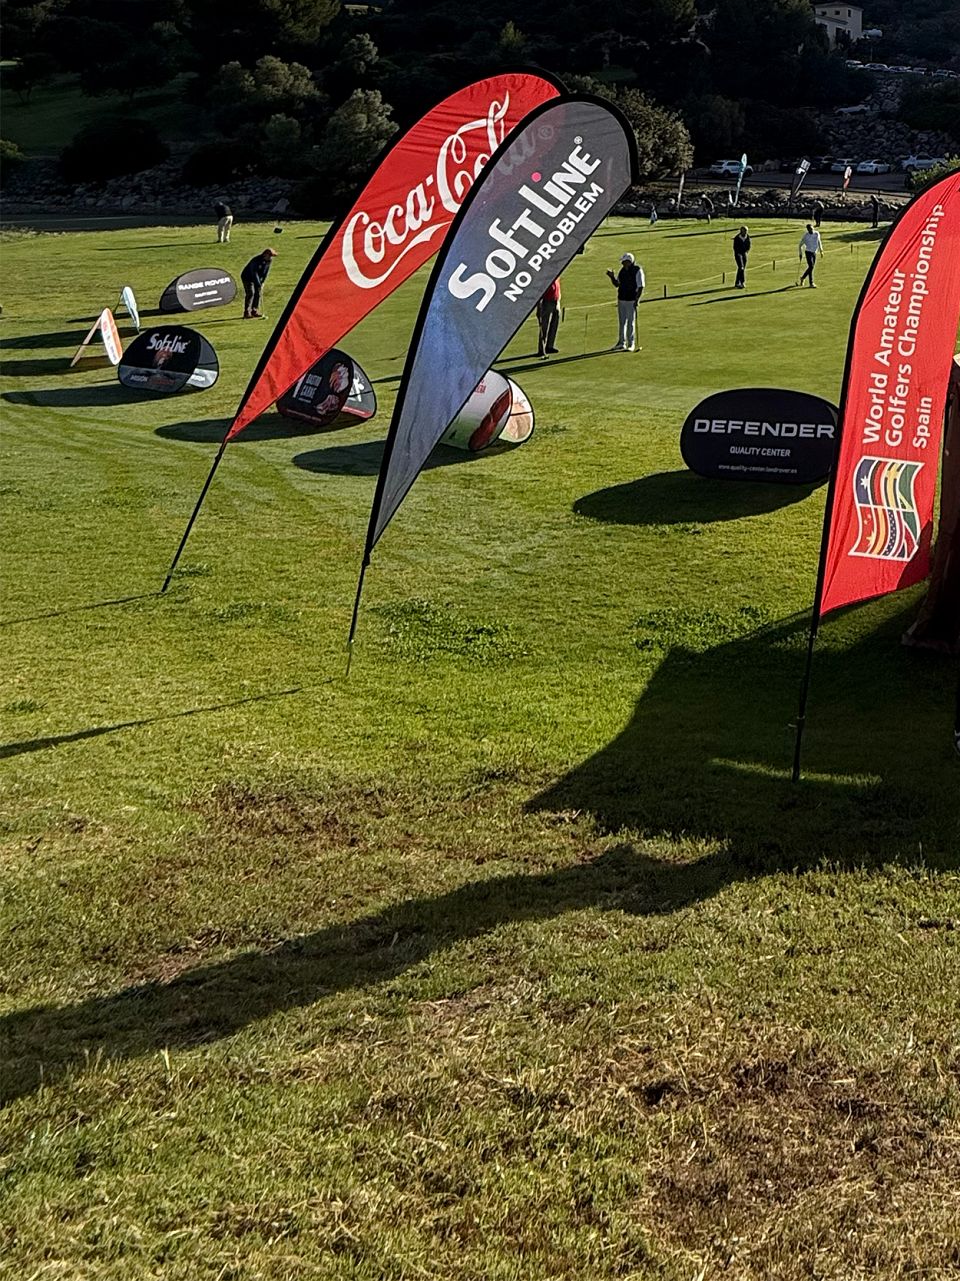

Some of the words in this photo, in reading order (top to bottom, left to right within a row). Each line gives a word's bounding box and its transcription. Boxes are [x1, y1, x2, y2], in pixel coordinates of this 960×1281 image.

[342, 90, 516, 289] Coca-Col
[503, 277, 532, 303] NO
[527, 182, 605, 271] PROBLEM
[898, 204, 945, 358] Championship
[178, 281, 204, 291] RANGE
[204, 277, 231, 287] ROVER
[874, 268, 907, 367] Amateur
[693, 419, 835, 439] DEFENDER
[862, 372, 889, 445] World
[885, 363, 913, 448] Golfers
[912, 396, 933, 449] Spain
[729, 445, 761, 456] QUALITY
[761, 447, 791, 457] CENTER
